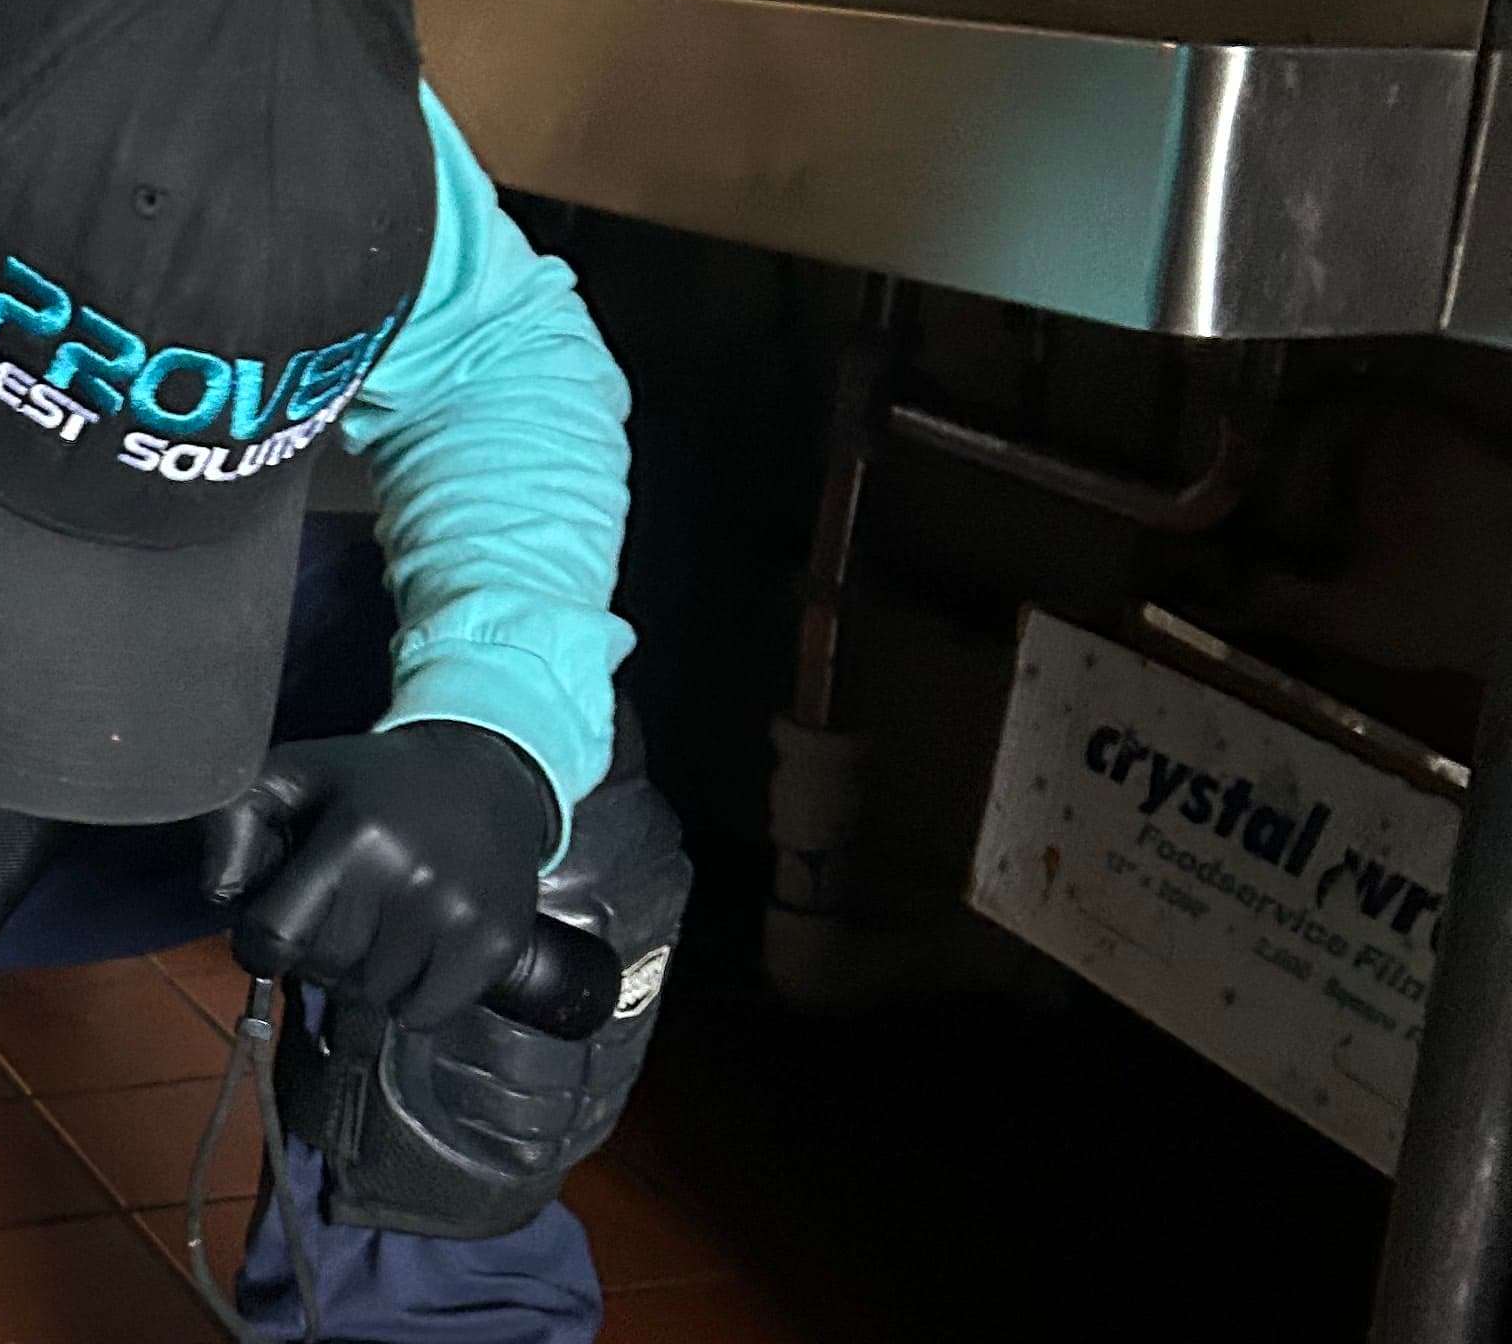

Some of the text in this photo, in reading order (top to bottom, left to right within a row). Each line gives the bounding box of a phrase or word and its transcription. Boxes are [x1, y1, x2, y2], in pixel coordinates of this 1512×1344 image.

[1084, 722, 1331, 878] crystal
[1317, 845, 1445, 952] wr
[1135, 823, 1350, 958] Foodservice
